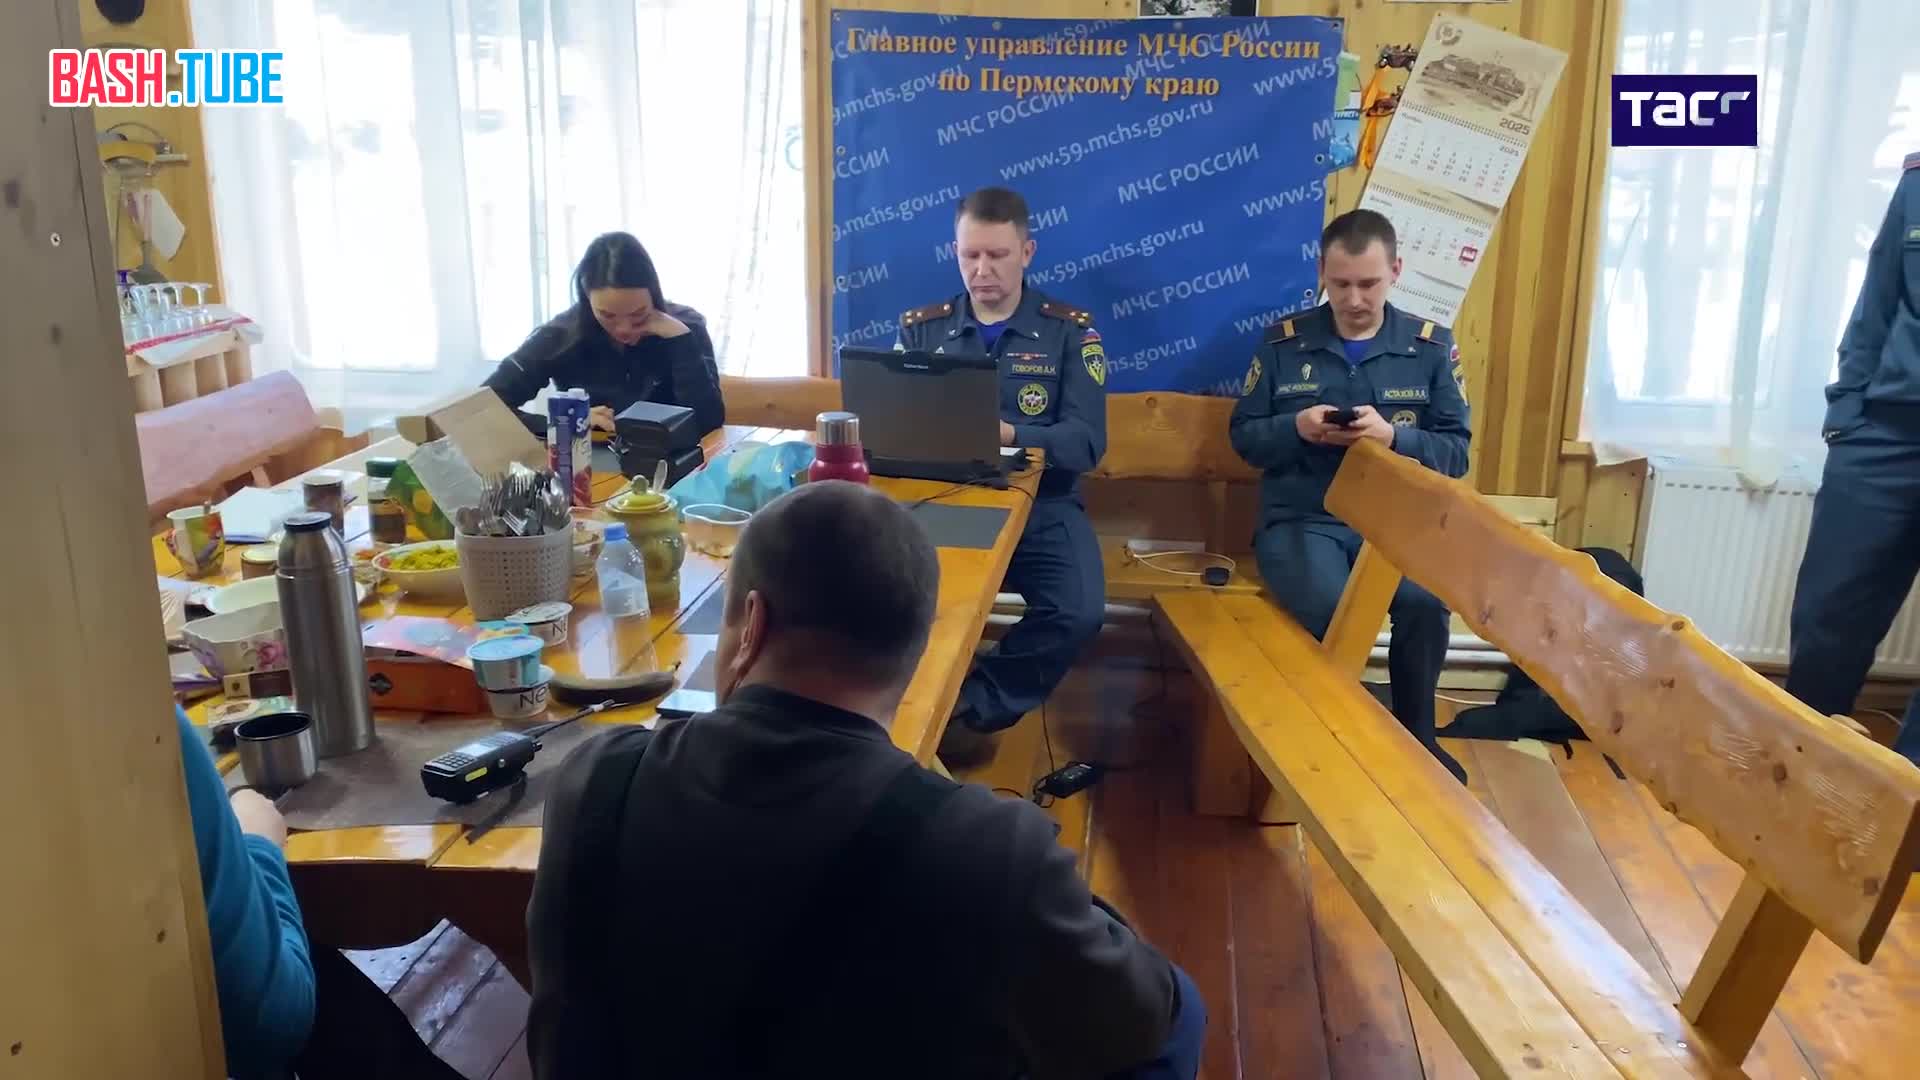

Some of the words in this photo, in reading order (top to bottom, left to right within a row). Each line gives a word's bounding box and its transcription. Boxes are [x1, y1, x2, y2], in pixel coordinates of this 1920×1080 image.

[848, 27, 957, 53] Главное
[965, 35, 1129, 61] управление
[1137, 32, 1212, 58] МЧС
[1220, 32, 1321, 59] России
[936, 73, 971, 91] по
[980, 67, 1134, 100] Пермскому
[1145, 77, 1220, 102] краю
[937, 116, 985, 146] МЧС
[988, 88, 1074, 128] РОССИИ
[1000, 99, 1214, 181] www.59.mchs.gov.ru
[1499, 117, 1531, 136] 2025
[1118, 173, 1168, 204] МЧС
[1170, 143, 1260, 187] РОССИИ
[1112, 291, 1160, 320] МЧС
[1163, 262, 1250, 304] РОССИИ
